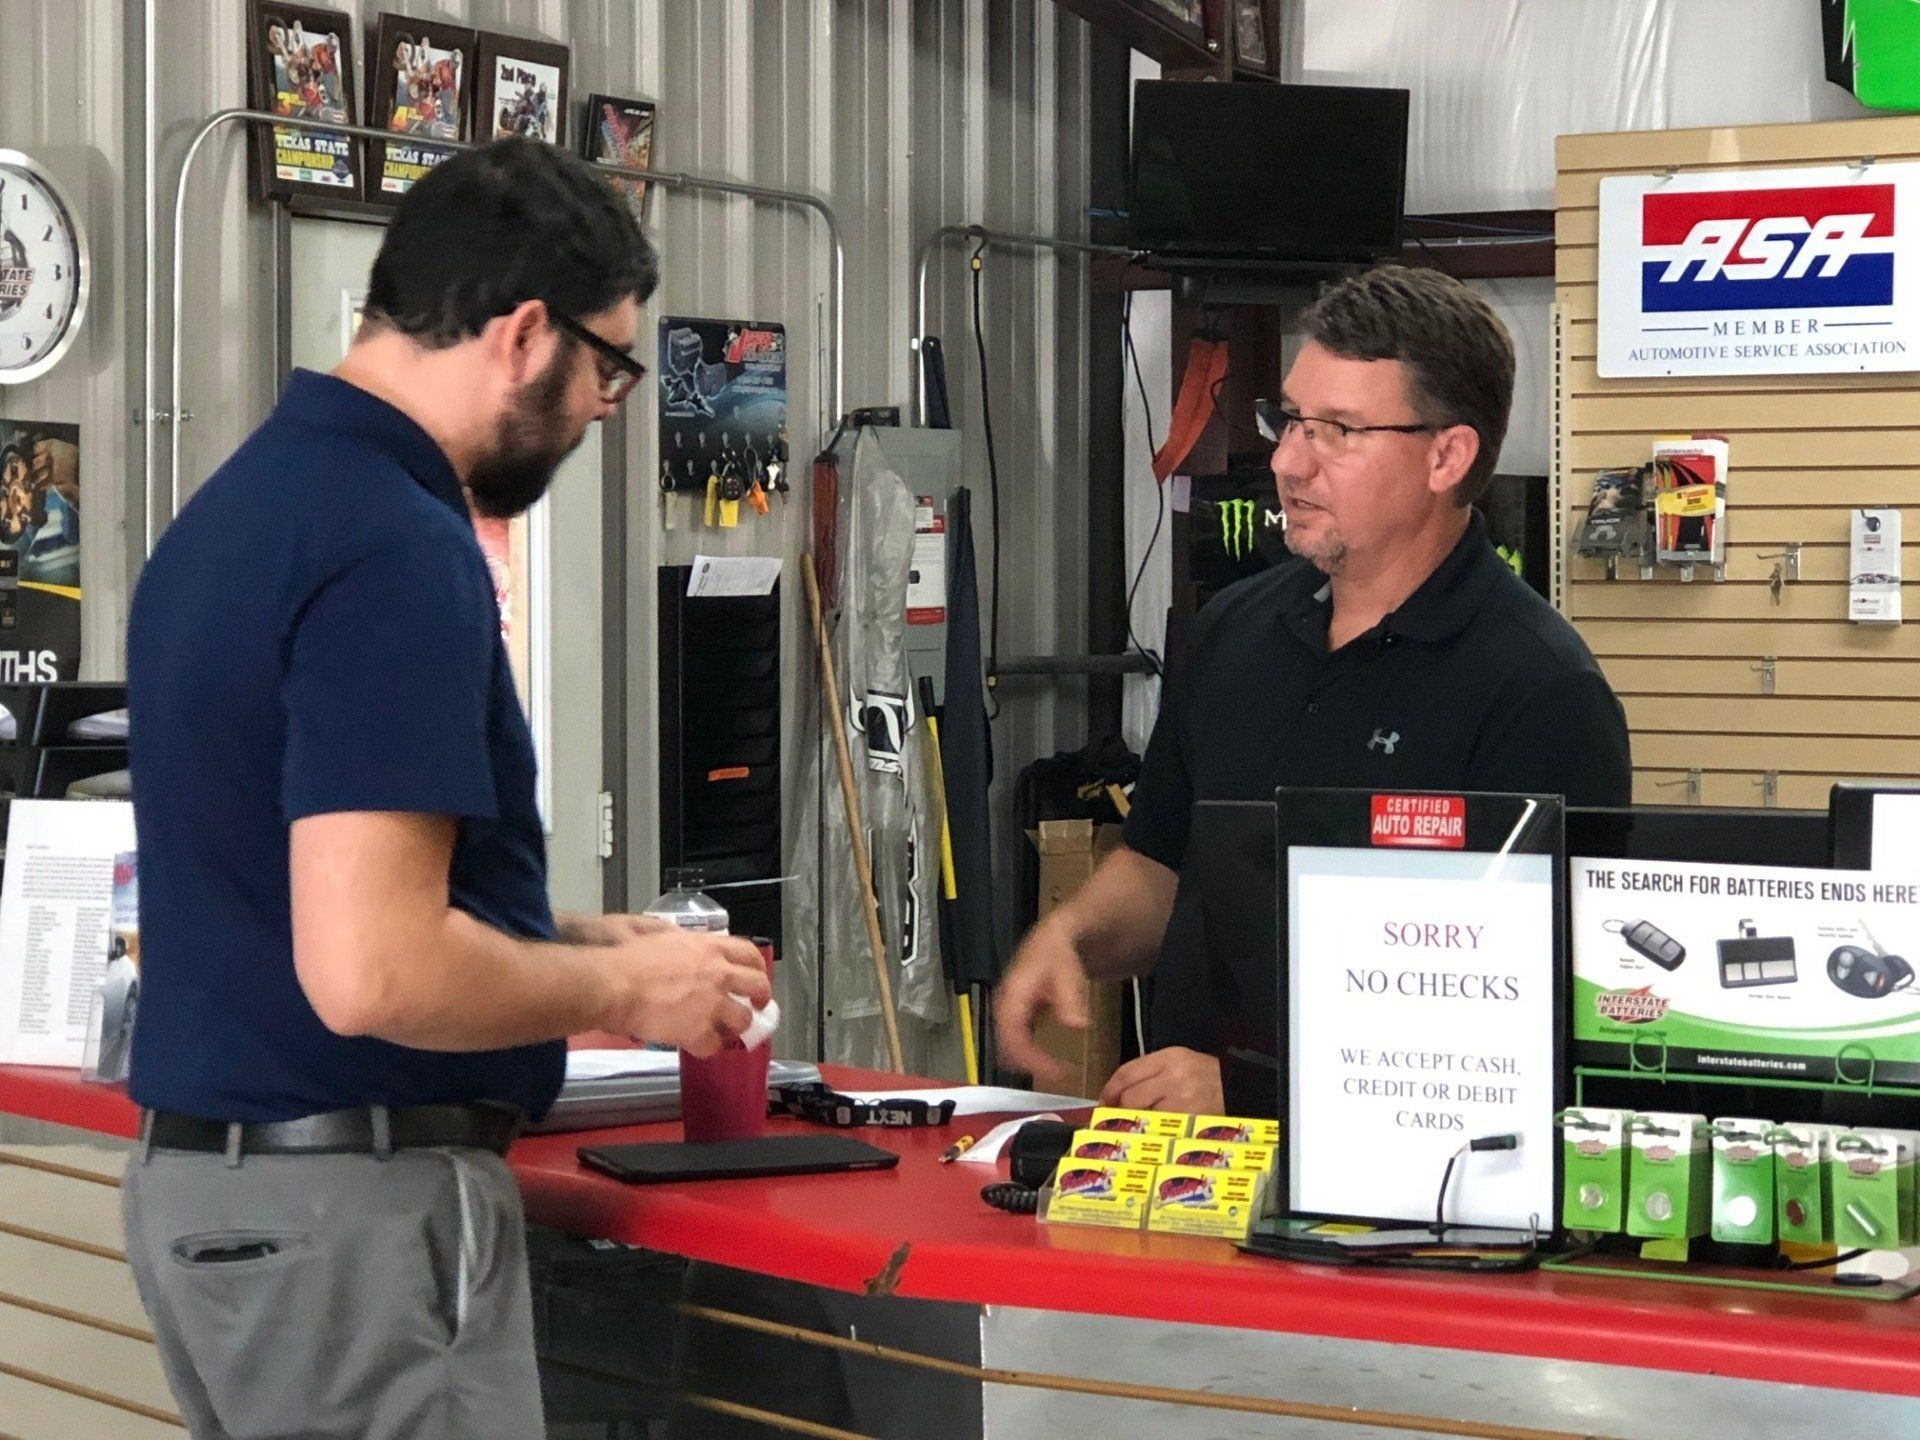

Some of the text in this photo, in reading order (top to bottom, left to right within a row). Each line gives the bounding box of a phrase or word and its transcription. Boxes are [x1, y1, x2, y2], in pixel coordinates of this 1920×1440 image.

[275, 134, 349, 156] TEXAS STATE
[386, 147, 419, 164] TEXAS
[21, 193, 28, 210] 1
[43, 224, 53, 242] 2
[1658, 213, 1876, 283] ASA
[1713, 319, 1819, 336] MEMBER
[1628, 341, 1907, 361] AUTOMOTIVE SERVICE ASSOCIATION
[1590, 517, 1622, 525] TRUCK
[0, 650, 58, 683] THS
[1387, 798, 1450, 814] CERTIFIED
[1372, 814, 1462, 837] AUTO REPAIR
[1586, 870, 1615, 889] THE
[1621, 871, 1683, 893] SEARCH
[1690, 875, 1720, 895] FOR
[1727, 877, 1815, 900] BATTERIES
[1821, 882, 1866, 902] ENDS
[1384, 921, 1484, 949] SORRY
[1346, 969, 1519, 1001] NO CHECKS
[1599, 995, 1670, 1007] INTERSTATE
[1600, 1006, 1664, 1017] BATTERIES
[1341, 1048, 1521, 1076] WE ACCEPT CASH,
[1697, 1054, 1807, 1071] interstatebatteries.com
[1343, 1077, 1518, 1104] CREDIT OR DEBIT
[866, 1110, 912, 1125] NEXT
[1396, 1110, 1465, 1131] CARDS
